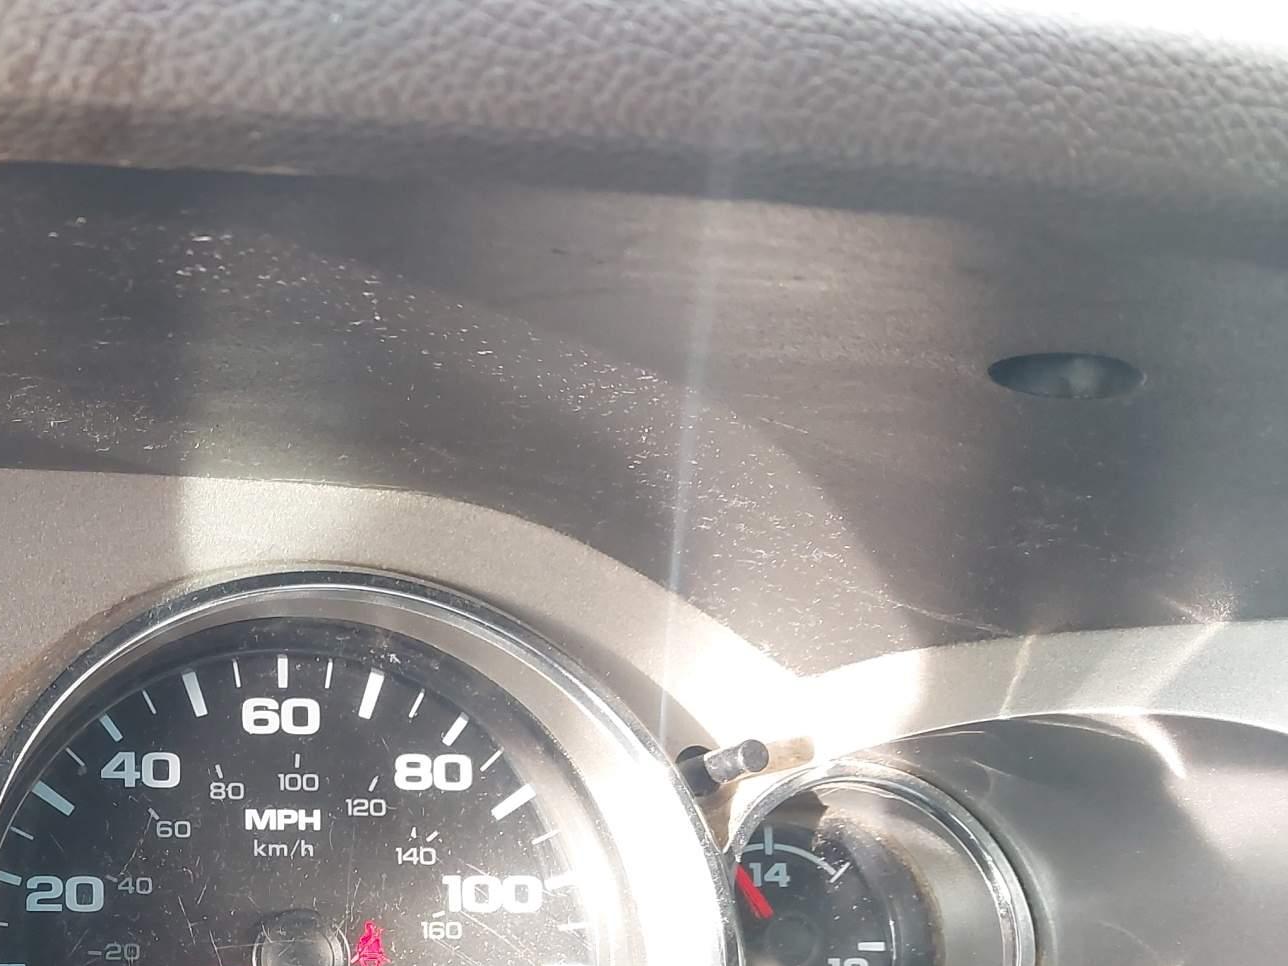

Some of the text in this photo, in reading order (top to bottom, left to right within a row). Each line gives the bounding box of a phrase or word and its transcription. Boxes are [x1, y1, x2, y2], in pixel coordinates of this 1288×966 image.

[241, 699, 320, 734] 60
[100, 752, 181, 788] 40
[394, 754, 472, 790] 80
[209, 782, 244, 800] 80
[277, 774, 319, 792] 100
[346, 799, 387, 817] 120
[156, 820, 191, 838] 60
[245, 810, 321, 831] MPH
[253, 840, 314, 858] km/h
[396, 847, 436, 865] 140
[749, 862, 791, 888] 14
[25, 877, 104, 912] 20
[118, 877, 153, 895] 40
[442, 875, 542, 913] 100
[422, 921, 462, 939] 160
[105, 943, 141, 961] 20
